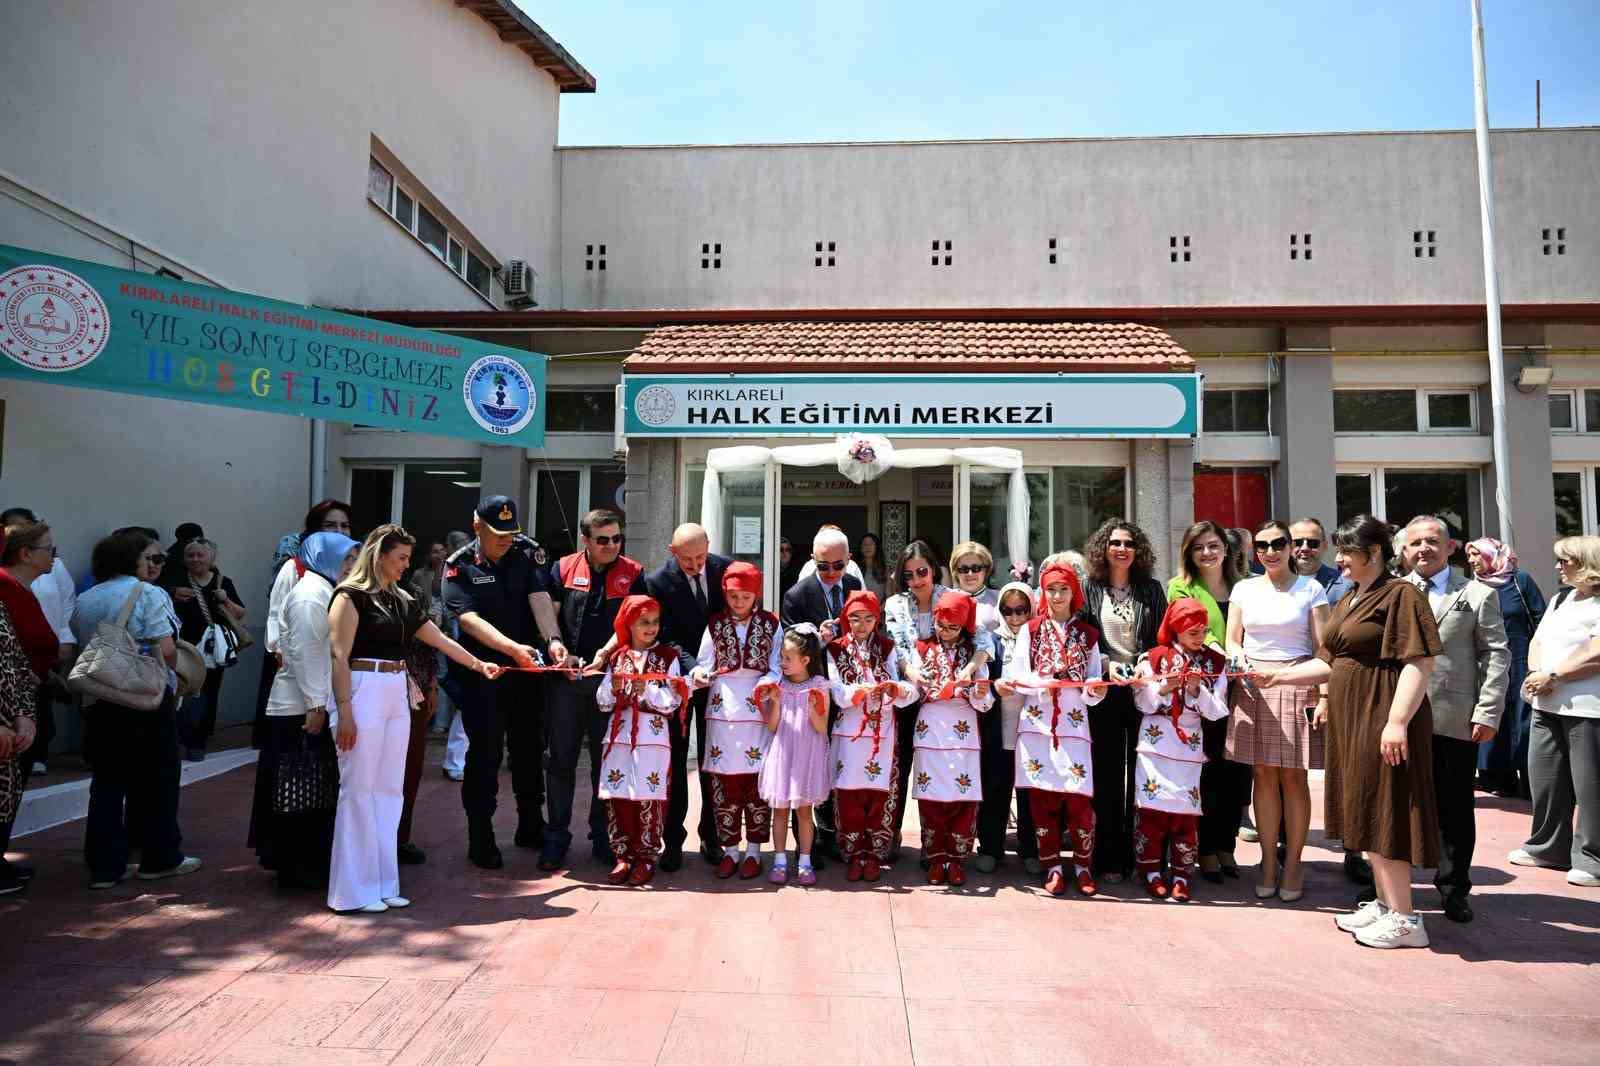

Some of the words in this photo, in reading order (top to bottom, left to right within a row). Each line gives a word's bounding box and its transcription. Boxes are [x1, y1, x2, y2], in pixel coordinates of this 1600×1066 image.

[219, 303, 260, 321] HALK
[130, 308, 190, 346] YIL
[200, 321, 298, 364] SONU
[306, 340, 453, 391] SERGİMİZE
[687, 386, 784, 401] KIRKLARELİ
[687, 406, 772, 425] HALK
[780, 403, 901, 425] EĞİTİMİ
[911, 402, 1054, 425] MERKEZİ
[491, 426, 509, 434] 1963
